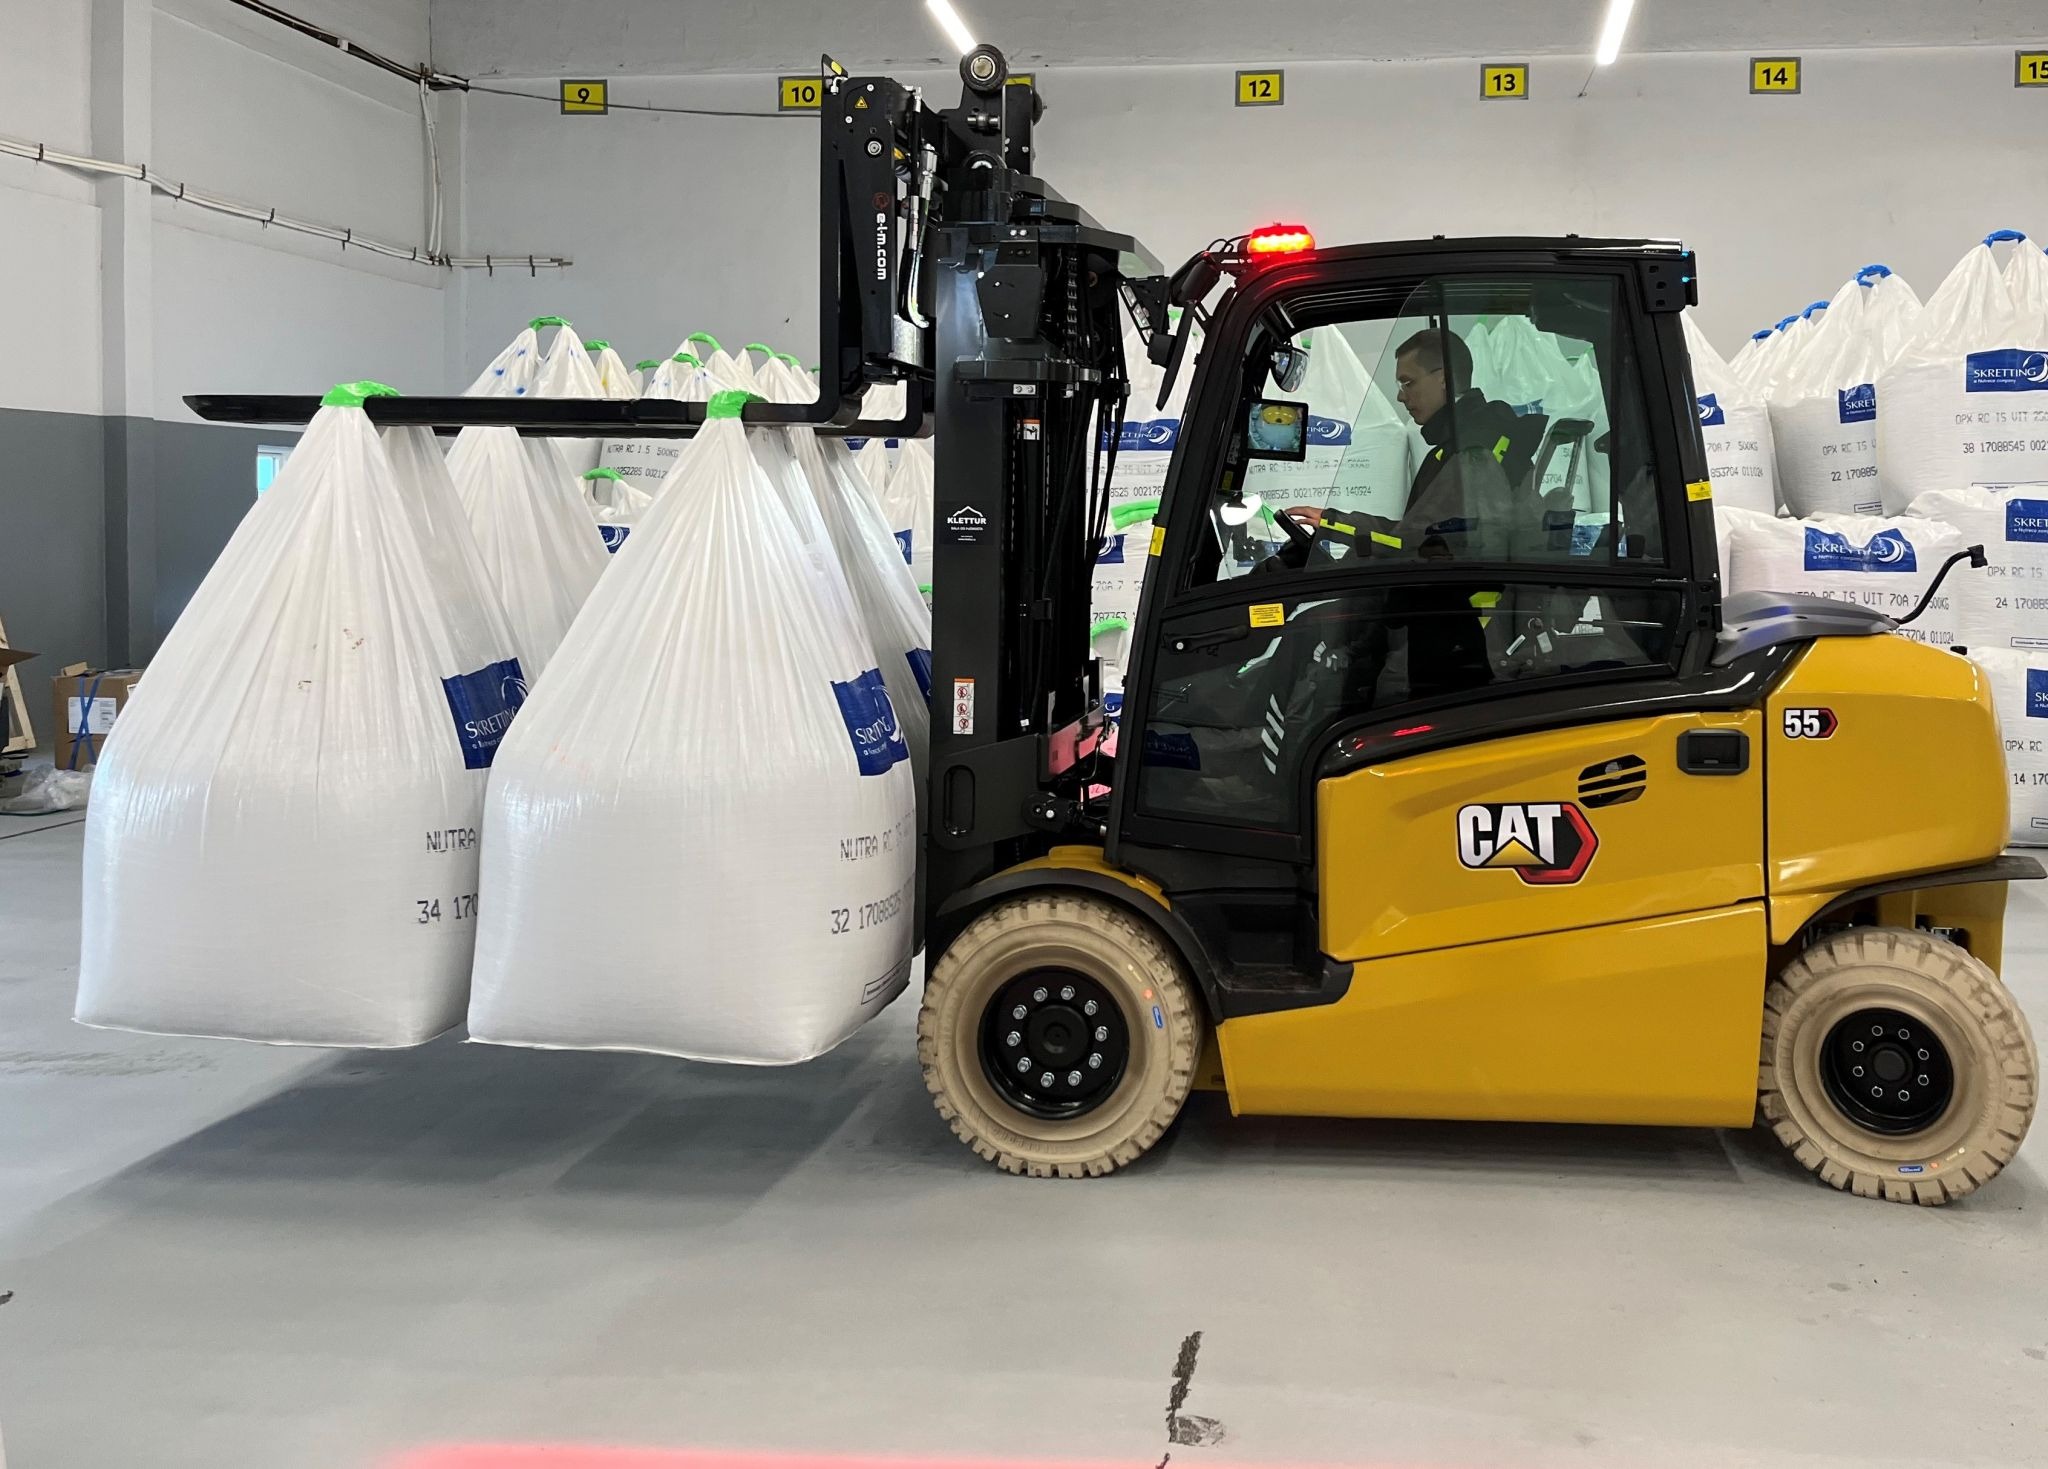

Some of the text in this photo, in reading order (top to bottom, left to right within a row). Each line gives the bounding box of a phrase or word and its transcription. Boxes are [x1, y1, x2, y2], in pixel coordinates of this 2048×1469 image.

[1761, 67, 1788, 86] 14
[2028, 60, 2048, 80] 15
[1248, 79, 1271, 98] 12
[1492, 73, 1517, 91] 13
[578, 87, 590, 104] 9
[791, 86, 816, 103] 10
[1973, 367, 2037, 378] SKRETTING
[1978, 412, 1991, 424] RC
[1963, 442, 1975, 454] 38
[1980, 440, 2026, 453] 17088545
[1831, 471, 1842, 482] 22
[1257, 488, 1290, 500] 7088525
[947, 517, 987, 525] KLETTUR
[1987, 566, 2006, 577] OPX
[2012, 566, 2025, 578] RC
[1844, 591, 1857, 604] IS
[1864, 592, 1883, 606] VIT
[1889, 593, 1910, 607] 70A
[1995, 596, 2008, 609] 24
[1785, 709, 1820, 737] 55
[2005, 740, 2043, 753] OPX RC
[2014, 773, 2026, 785] 14
[426, 827, 476, 853] NUTRA
[1459, 804, 1562, 866] CAT
[840, 835, 878, 861] NUTRA
[417, 893, 479, 924] 34 170
[831, 908, 851, 935] 32
